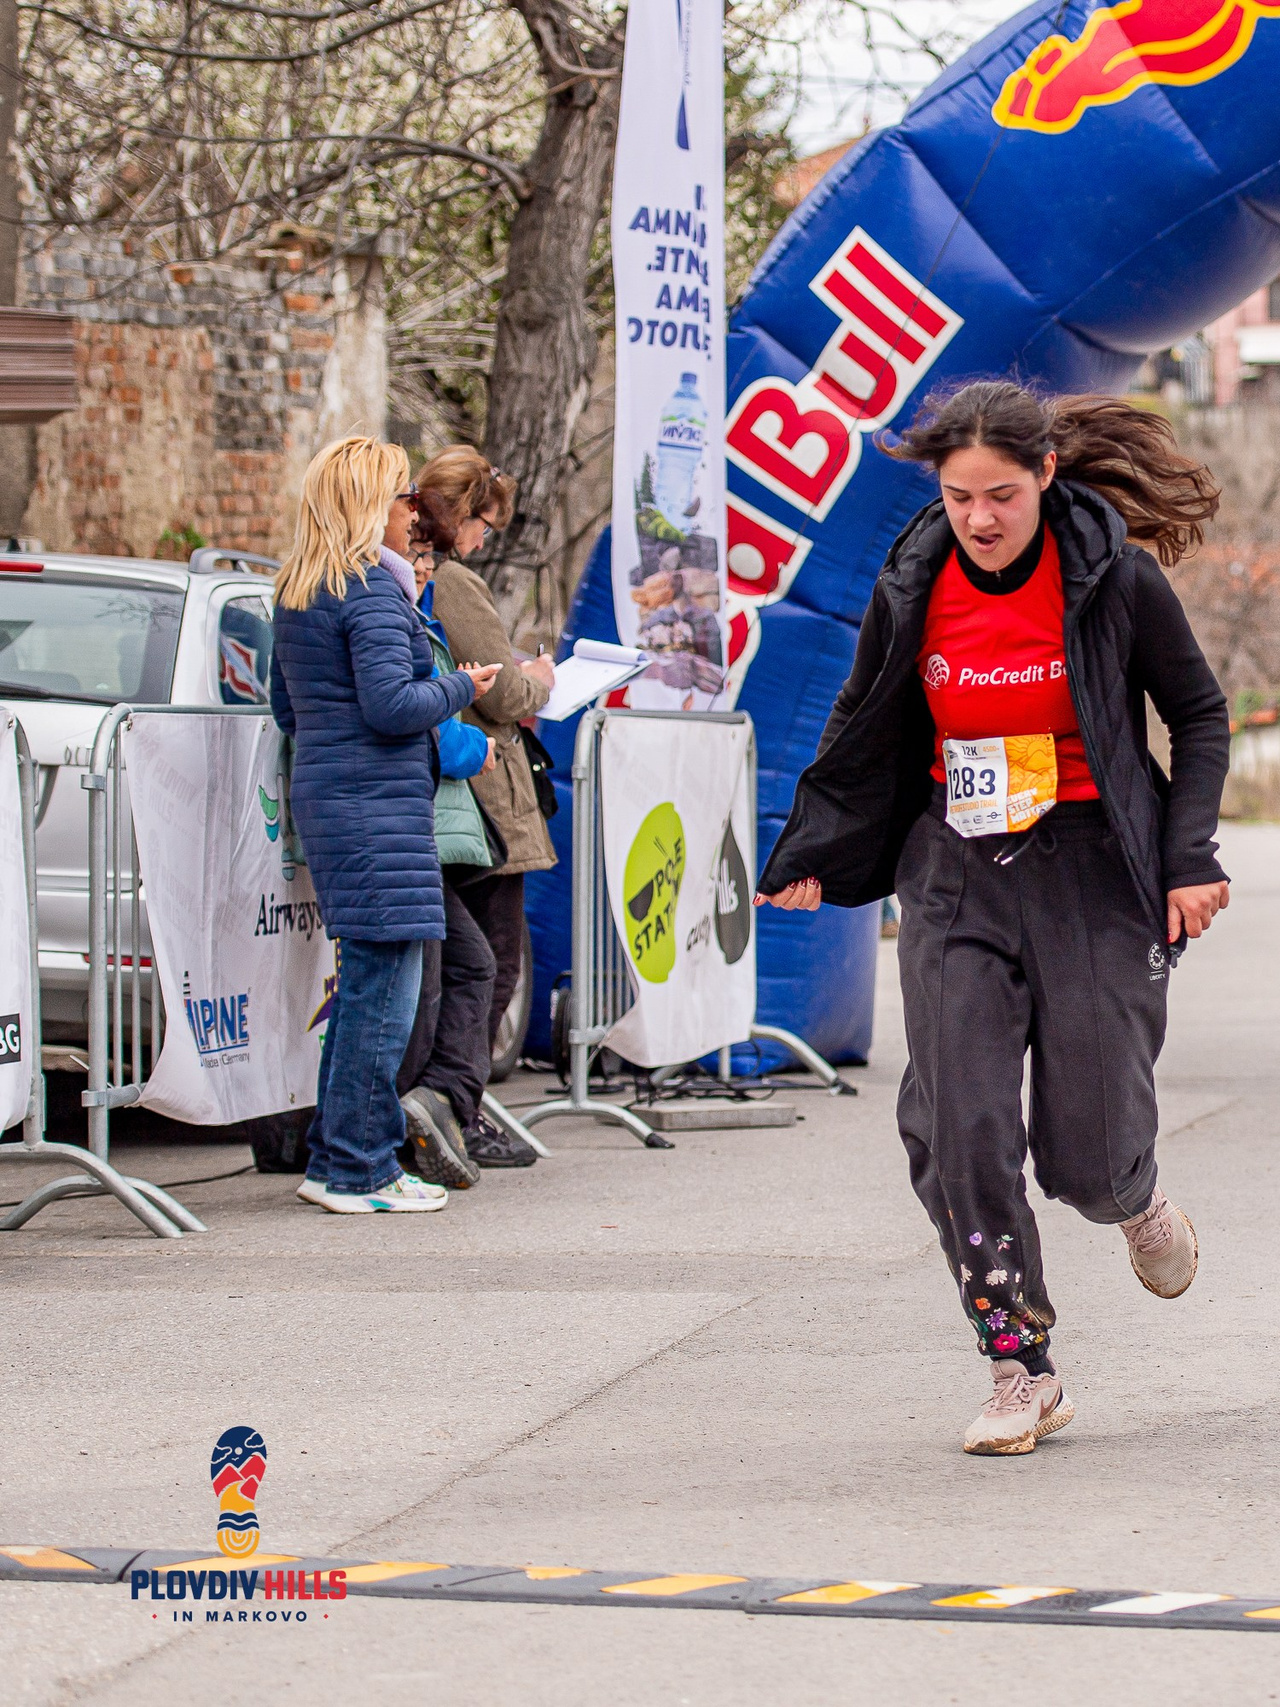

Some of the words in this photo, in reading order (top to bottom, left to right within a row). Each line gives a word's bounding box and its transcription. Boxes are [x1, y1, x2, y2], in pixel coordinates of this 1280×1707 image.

[726, 242, 948, 507] Bull
[958, 665, 1044, 686] ProCredit
[961, 745, 978, 756] 12K
[948, 766, 996, 801] 1283
[254, 892, 323, 942] Airways
